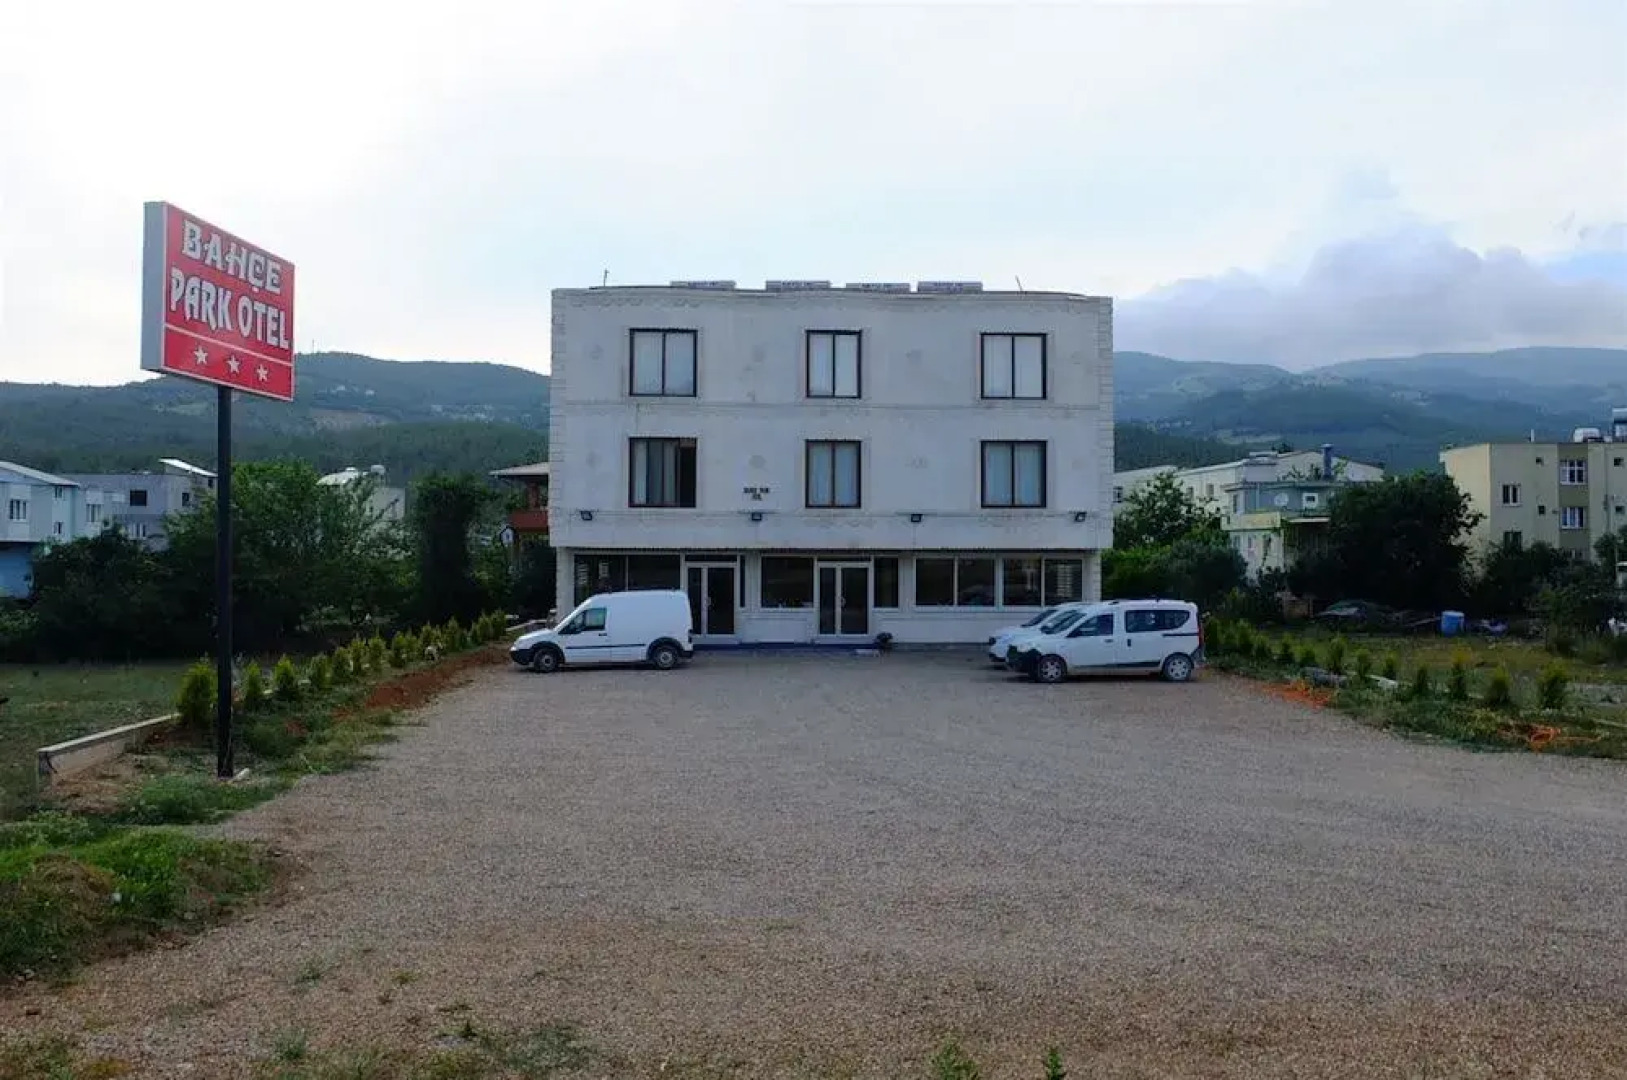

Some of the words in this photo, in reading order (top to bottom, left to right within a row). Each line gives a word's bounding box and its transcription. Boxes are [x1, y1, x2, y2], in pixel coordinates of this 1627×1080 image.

[182, 220, 281, 294] BAHÇE
[170, 267, 232, 331] PARK
[238, 295, 289, 349] OTEL
